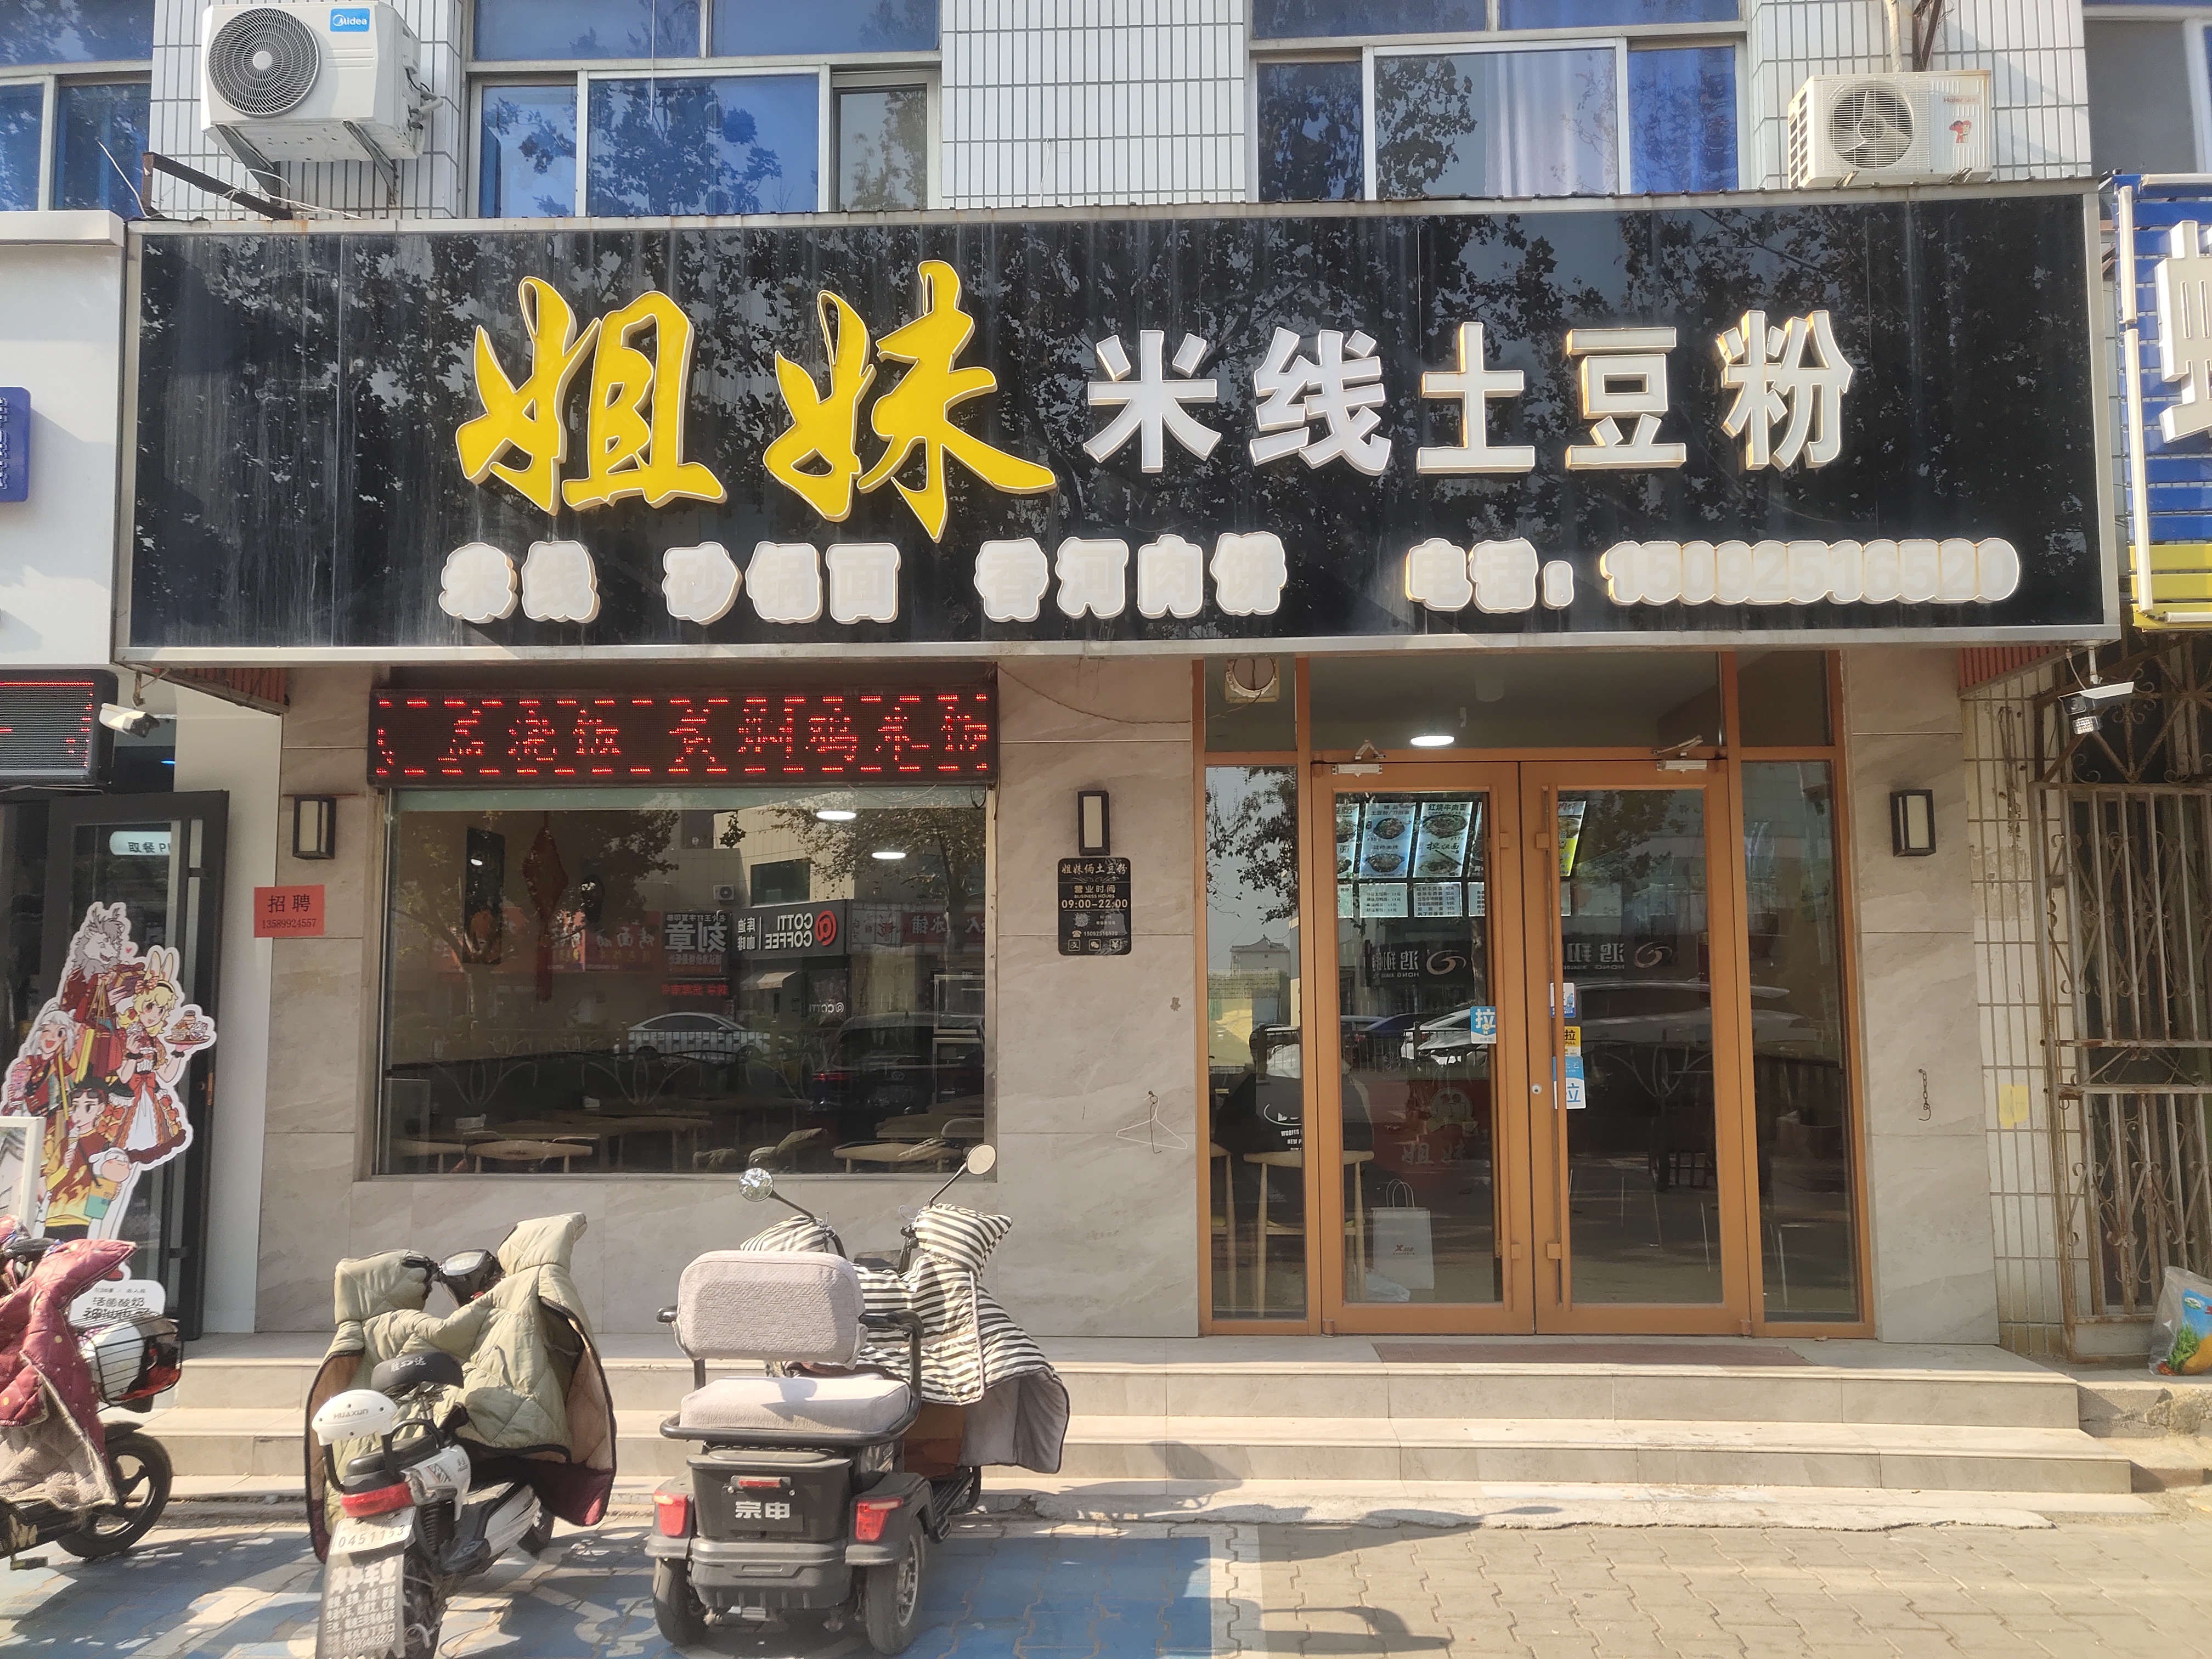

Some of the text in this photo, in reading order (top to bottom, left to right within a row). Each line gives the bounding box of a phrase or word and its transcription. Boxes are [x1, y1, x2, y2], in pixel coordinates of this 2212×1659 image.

[333, 14, 367, 26] Midea
[455, 260, 1853, 543] 姐妹 米线土豆粉
[444, 548, 591, 614] 米线
[666, 546, 895, 616] 砂锅面
[979, 537, 1283, 614] 香河肉饼
[1606, 540, 2012, 599] 15092516520
[127, 842, 155, 853] 取餐
[1062, 863, 1127, 875] 姐妹俩土豆粉
[1074, 885, 1116, 893] 营业时间
[268, 894, 311, 913] 招聘
[1475, 1008, 1496, 1029] 拉
[333, 1408, 369, 1420] HUAXUN
[735, 1501, 791, 1520] 宗申
[338, 1525, 405, 1548] 0451153
